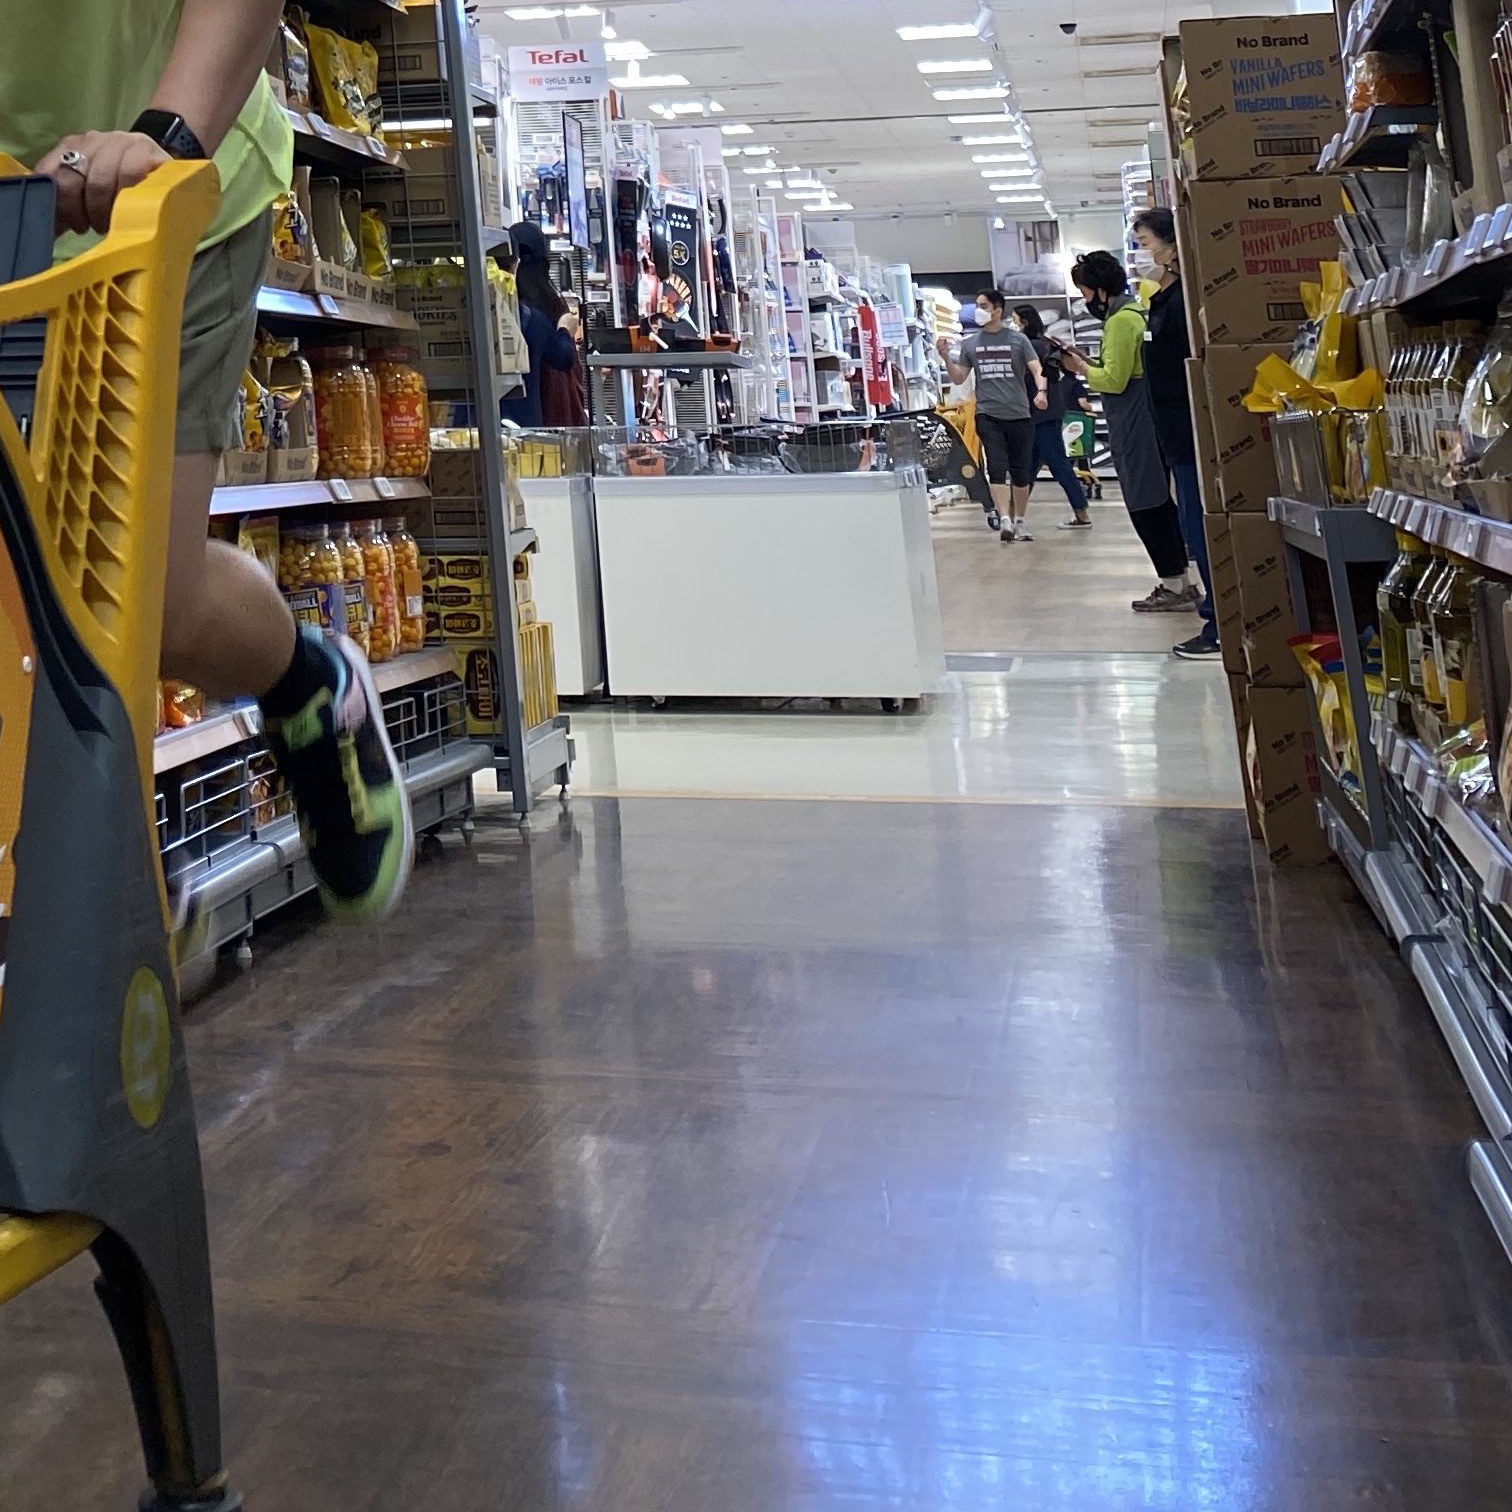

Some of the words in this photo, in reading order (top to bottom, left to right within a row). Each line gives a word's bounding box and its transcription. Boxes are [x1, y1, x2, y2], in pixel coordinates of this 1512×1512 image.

[1237, 36, 1259, 49] No
[1261, 33, 1309, 48] Brand
[526, 48, 590, 65] Tefal
[1229, 56, 1283, 76] VANILLA
[1232, 74, 1266, 96] MINI
[1267, 58, 1326, 88] WAFERS
[1247, 197, 1270, 210] No
[1272, 194, 1322, 209] Brand
[1241, 237, 1276, 257] MINI
[1276, 220, 1337, 250] WAFERS
